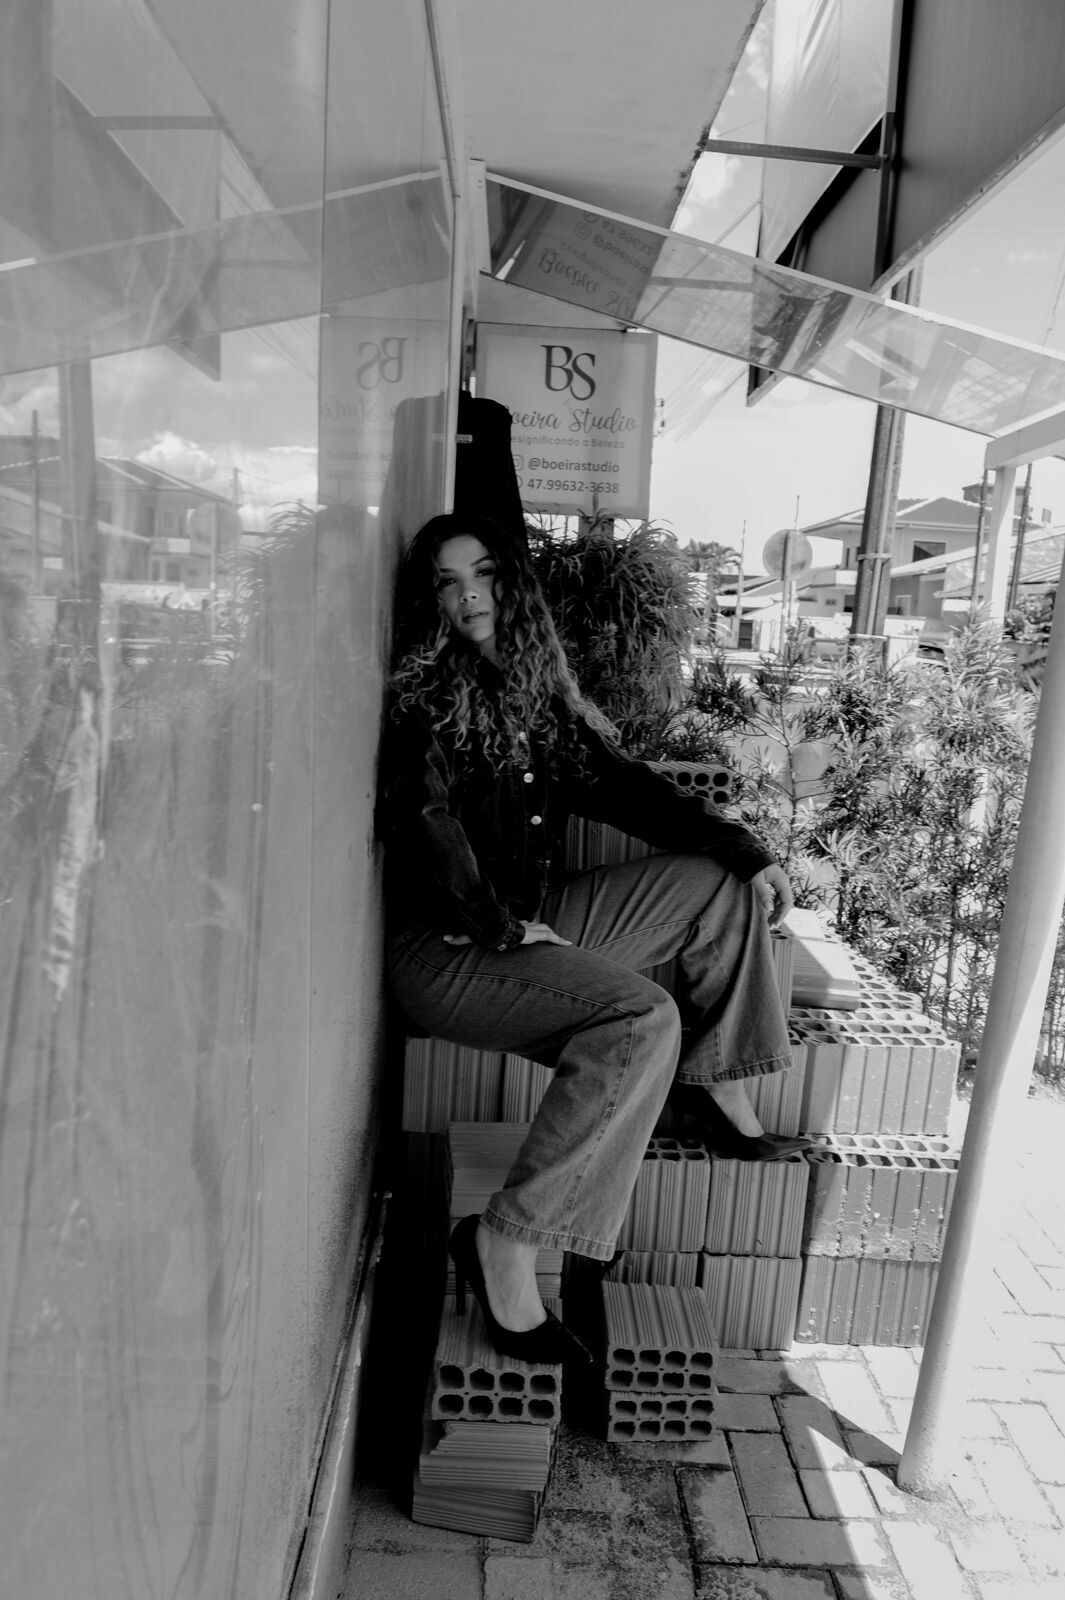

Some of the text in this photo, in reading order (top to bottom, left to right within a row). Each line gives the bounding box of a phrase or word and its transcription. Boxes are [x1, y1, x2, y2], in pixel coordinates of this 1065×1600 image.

[541, 345, 596, 401] BS
[509, 408, 637, 434] oeira Studio
[511, 435, 580, 446] esignificando
[528, 458, 620, 473] @boeirastudio
[527, 479, 620, 494] 47.99632-3638
